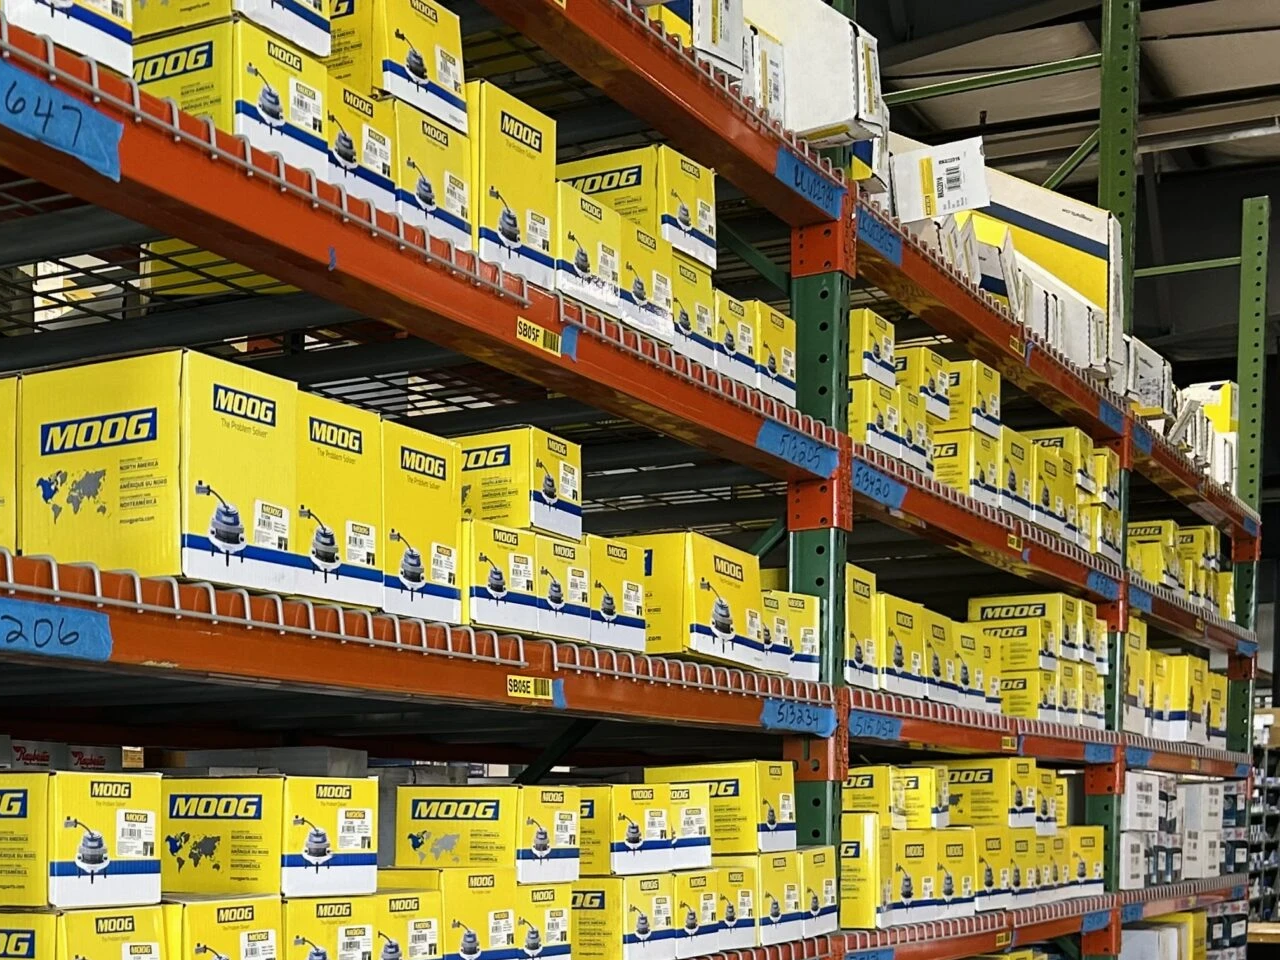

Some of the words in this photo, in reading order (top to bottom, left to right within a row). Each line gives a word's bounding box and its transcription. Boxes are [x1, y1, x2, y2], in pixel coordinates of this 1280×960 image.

[269, 44, 301, 69] MOOG
[345, 92, 372, 116] MOOG
[424, 123, 448, 145] MOOG
[502, 114, 541, 149] MOOG
[582, 200, 601, 219] MOOG
[517, 320, 540, 343] SB05F
[217, 388, 273, 422] MOOG
[46, 413, 152, 452] MOOG
[312, 421, 361, 452] MOOG
[549, 440, 566, 454] MOOG
[403, 451, 445, 478] MOOG
[495, 531, 518, 544] MOOG
[716, 558, 742, 579] MOOG
[983, 606, 1045, 618] MOOG
[508, 677, 531, 694] SB05E
[777, 704, 818, 729] 513234
[92, 783, 129, 796] MOOG
[318, 786, 350, 798] MOOG
[542, 792, 562, 801] MOOG
[172, 798, 259, 816] MOOG
[414, 802, 496, 818] MOOG
[126, 813, 146, 822] MOOG
[470, 877, 493, 886] MOOG
[533, 891, 553, 901] MOOG
[318, 905, 350, 916] MOOG
[391, 900, 418, 911] MOOG
[219, 908, 252, 921] MOOG
[98, 918, 133, 932] MOOG
